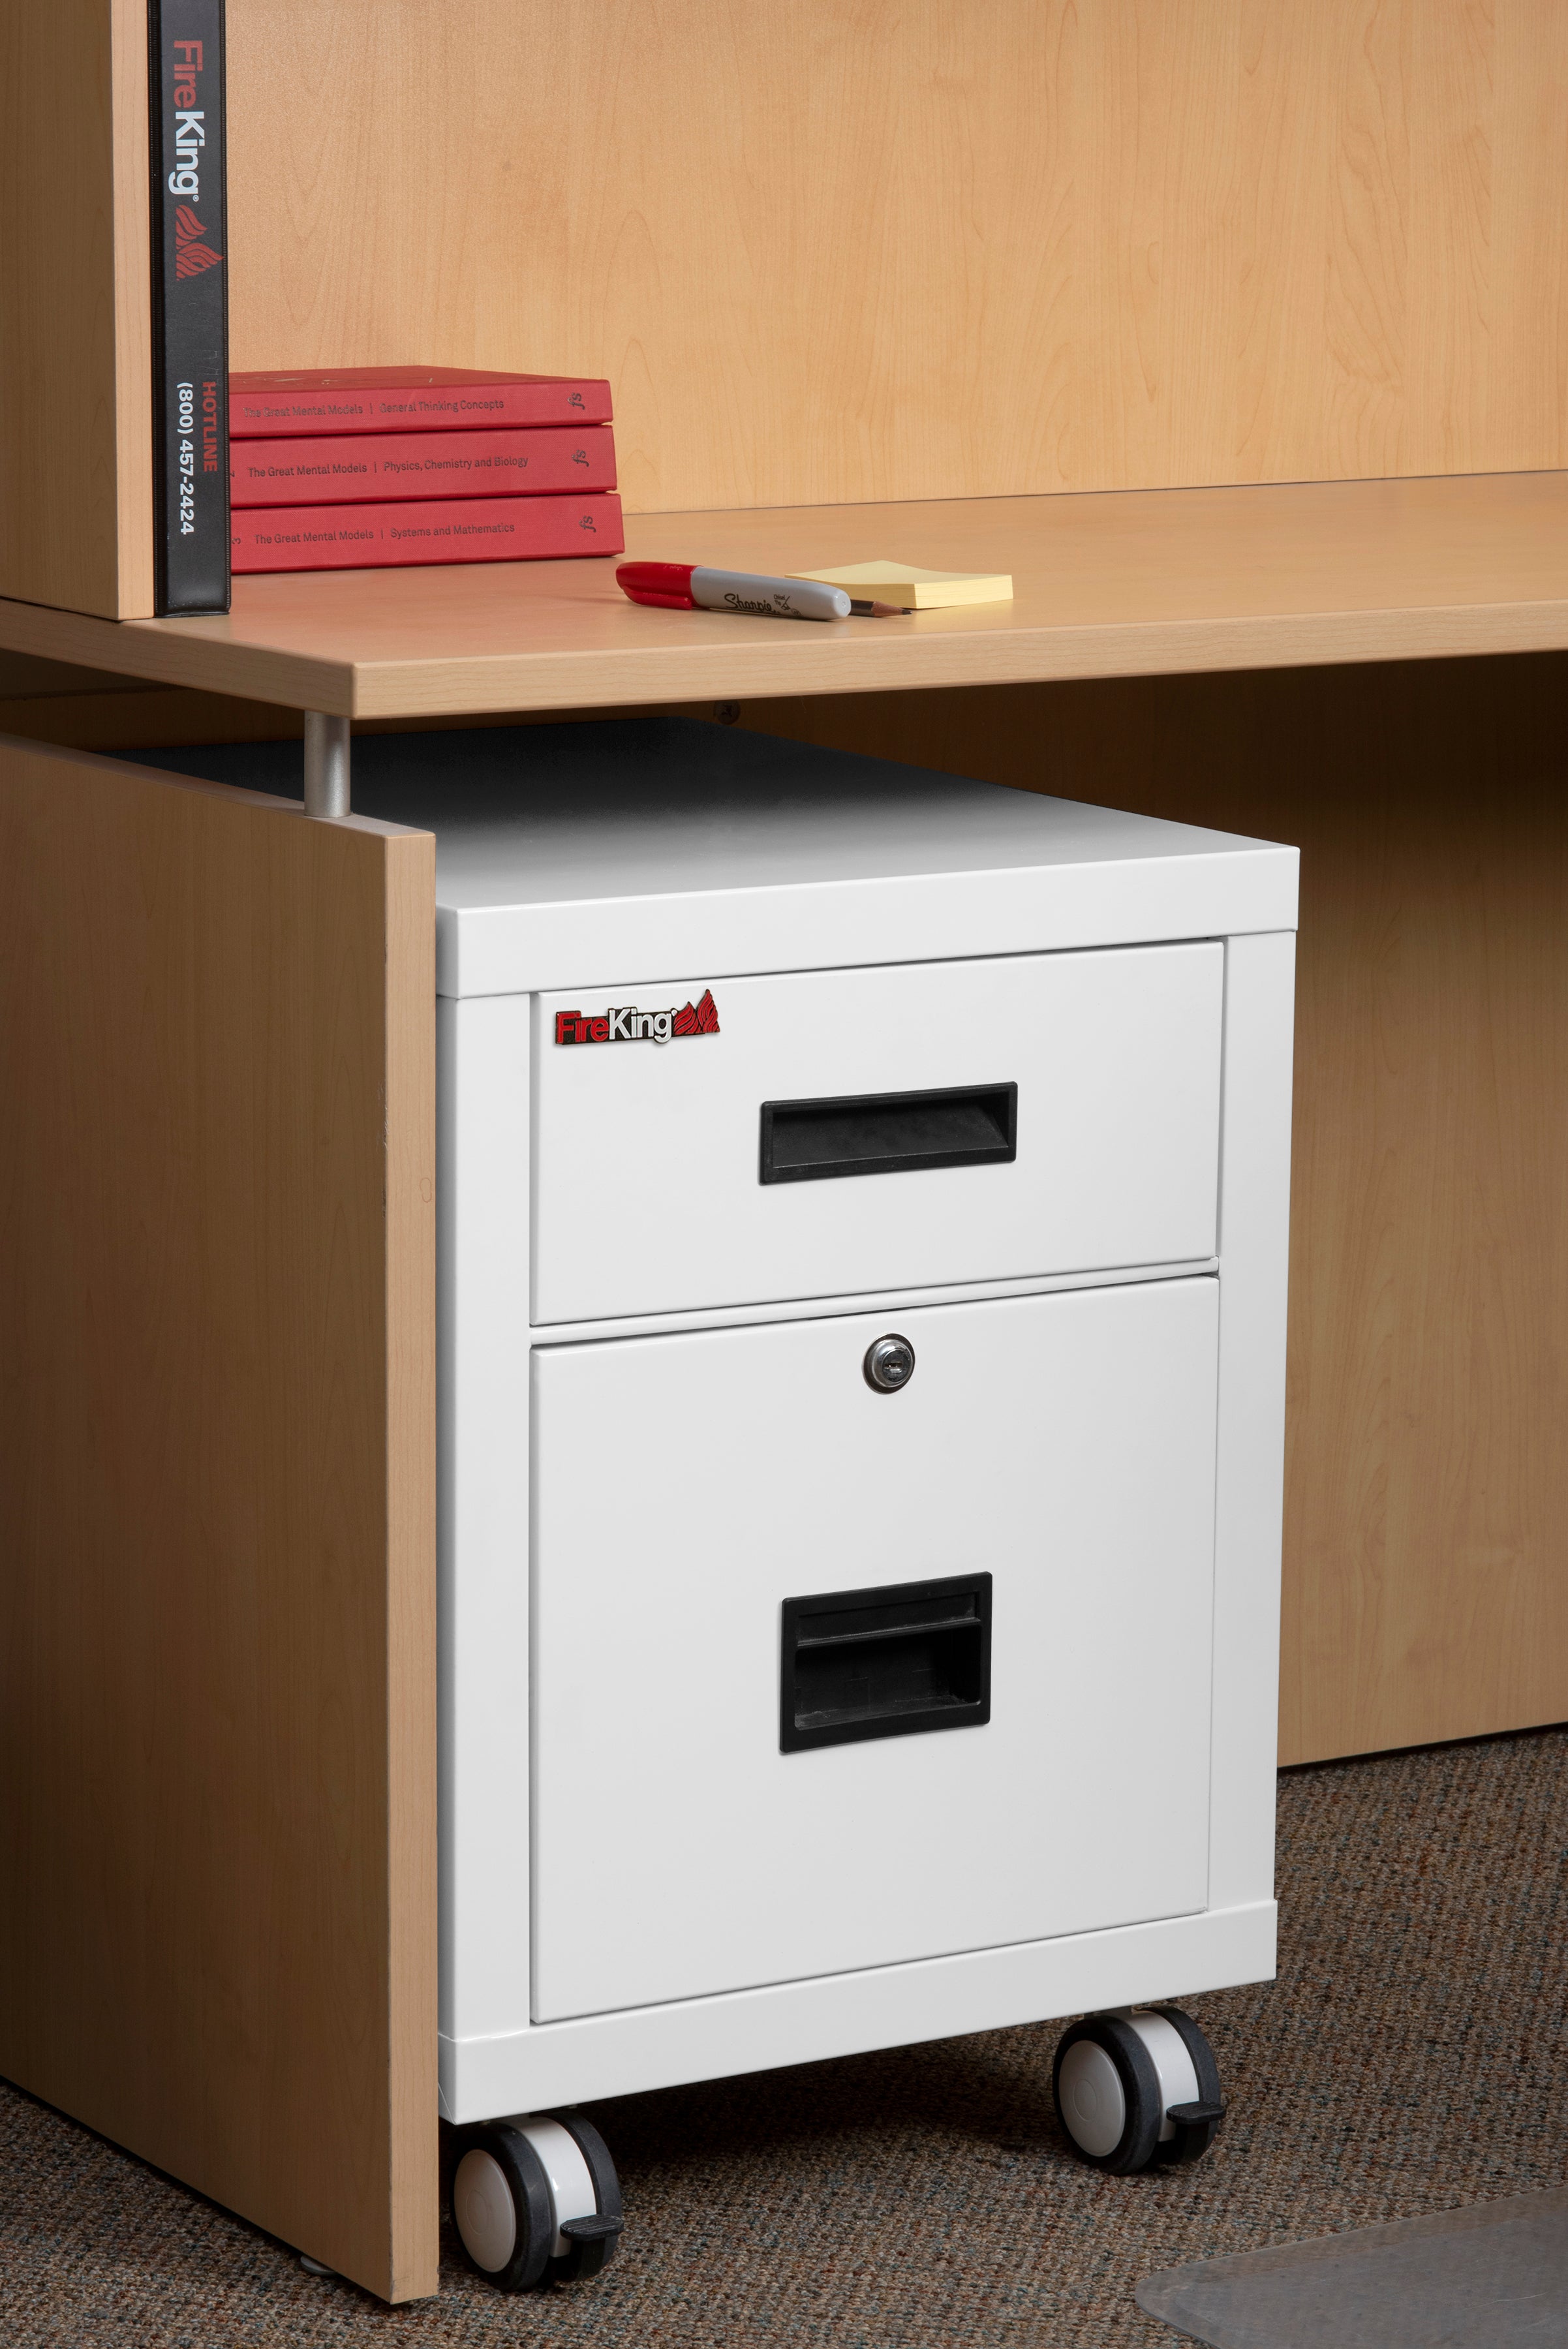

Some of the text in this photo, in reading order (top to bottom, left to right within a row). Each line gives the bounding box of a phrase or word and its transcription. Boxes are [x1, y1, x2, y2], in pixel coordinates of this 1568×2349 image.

[243, 399, 504, 418] The Great Mental Models General Thinking Concepts
[202, 381, 218, 472] HOTLINE
[176, 382, 194, 535] (800) 457-2424
[247, 467, 266, 478] The
[268, 466, 294, 477] Great
[296, 464, 330, 476] Mental
[332, 463, 367, 474] Models
[384, 461, 423, 473] Physics,
[424, 458, 472, 470] Chemistry
[474, 457, 492, 468] and
[494, 455, 529, 468] Biology
[254, 523, 515, 544] The Great Mental Models Systems and Mathematics
[556, 1007, 673, 1043] FireKing
